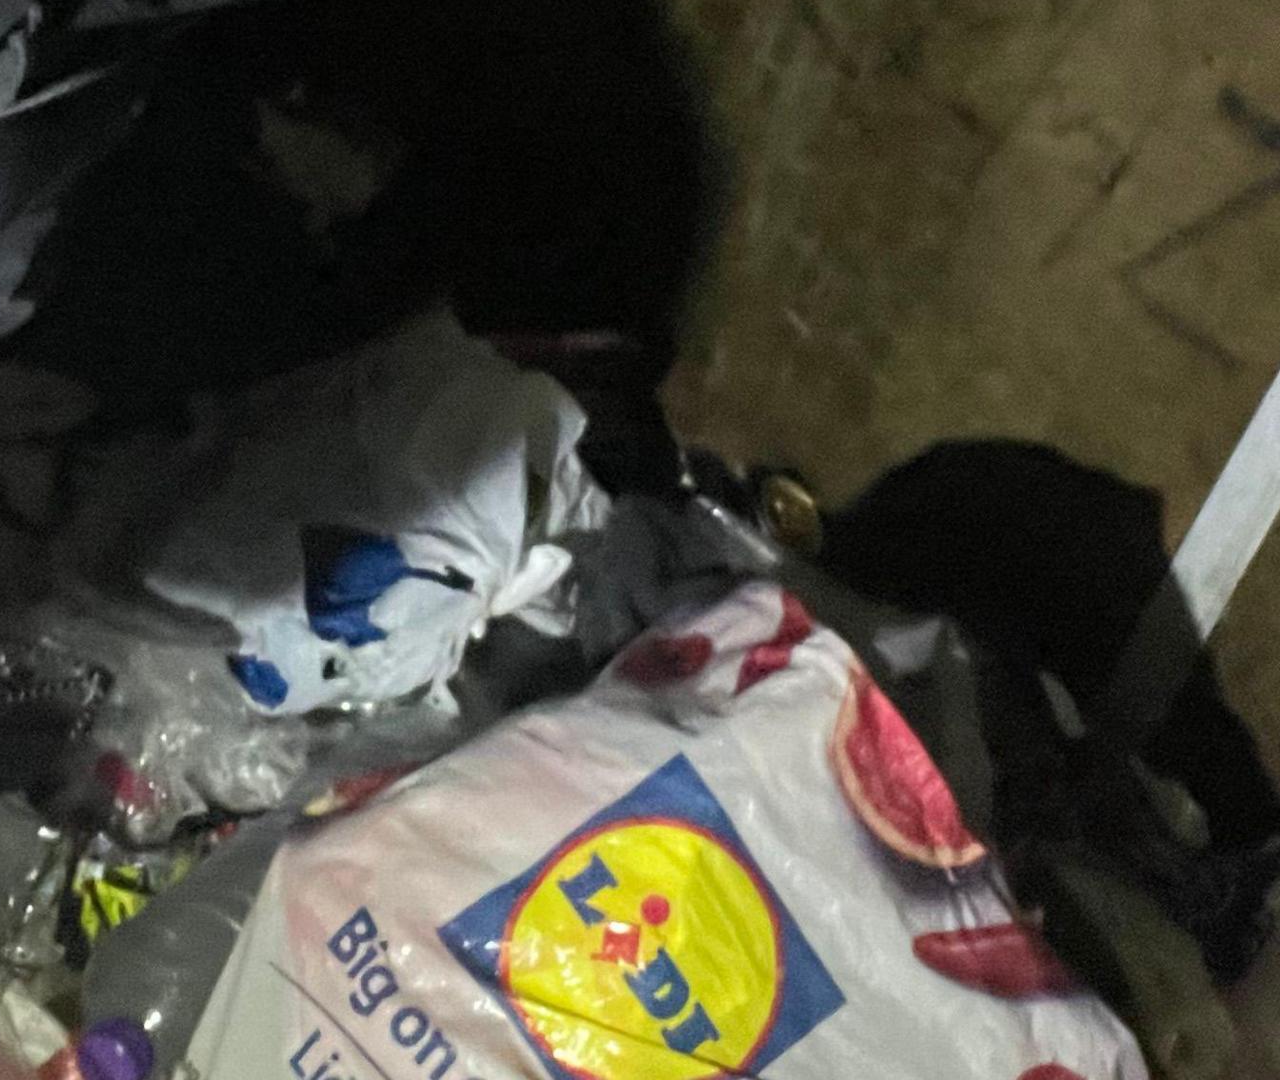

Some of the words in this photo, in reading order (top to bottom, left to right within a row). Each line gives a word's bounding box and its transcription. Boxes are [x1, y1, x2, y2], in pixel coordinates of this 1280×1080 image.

[327, 906, 400, 1017] Big
[390, 1007, 458, 1080] on
[290, 1028, 357, 1080] Li
